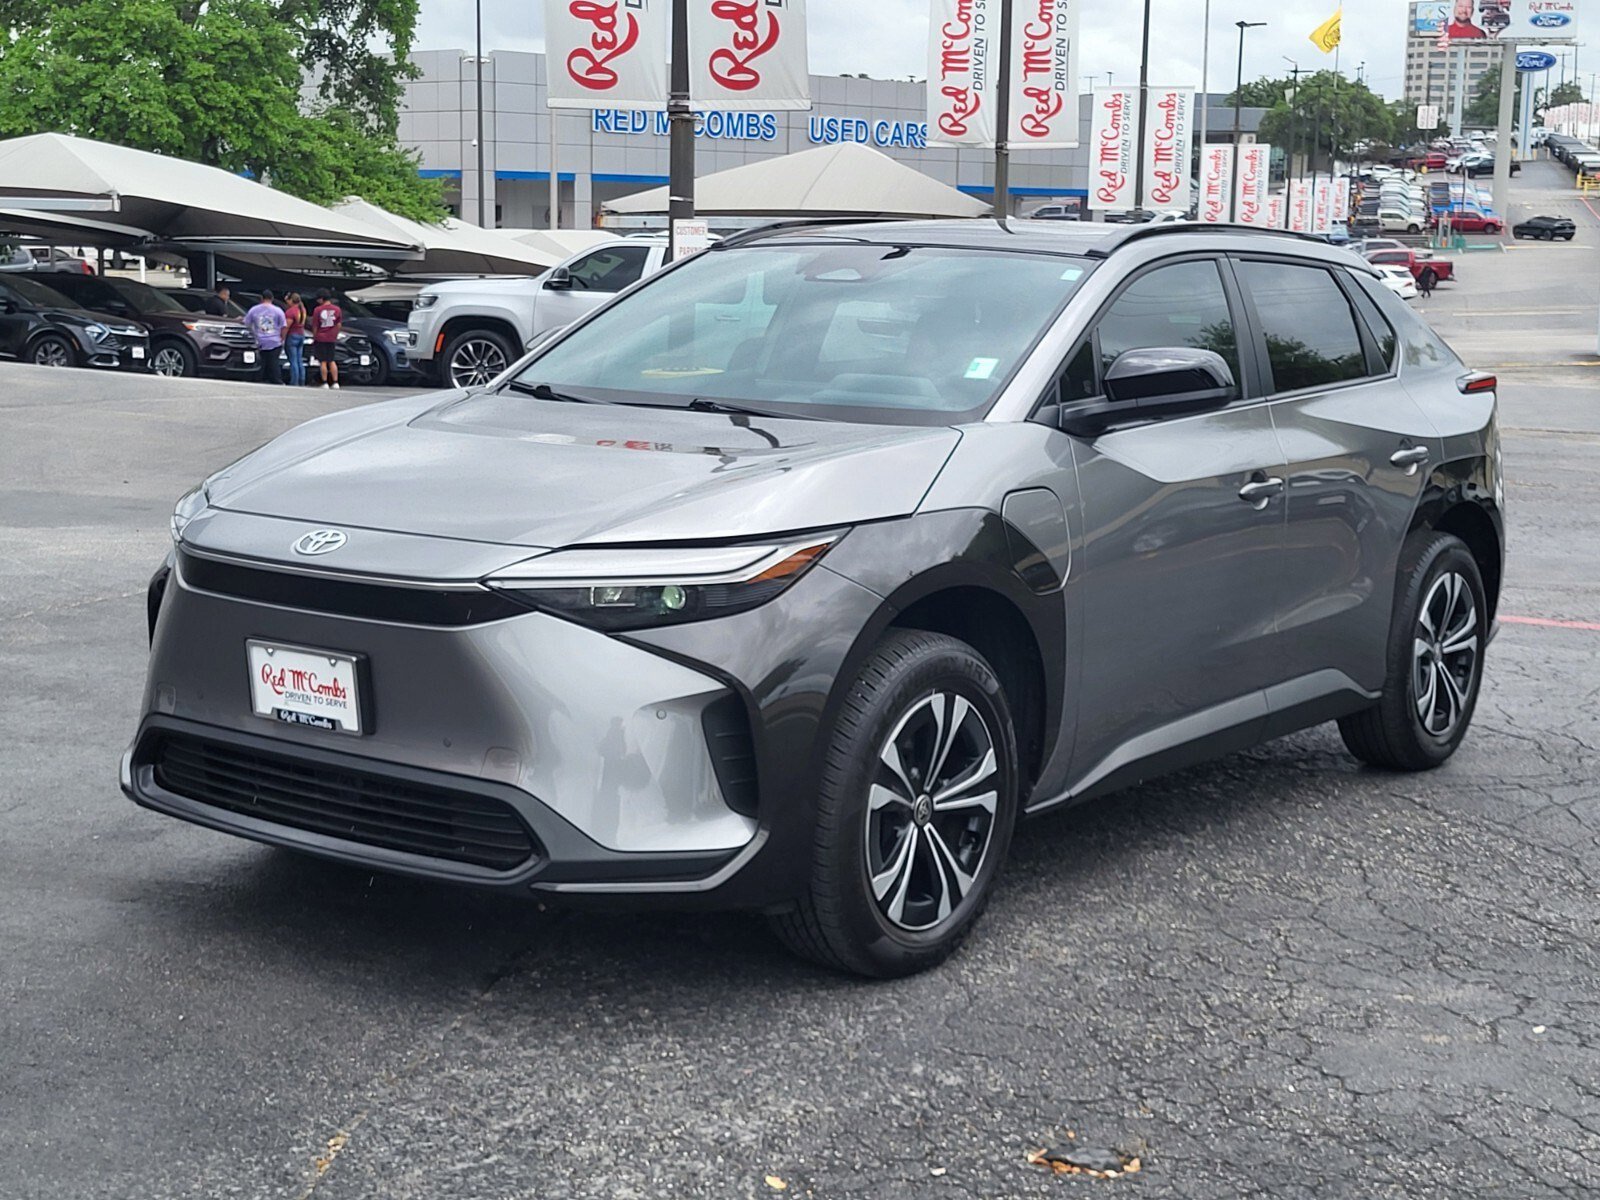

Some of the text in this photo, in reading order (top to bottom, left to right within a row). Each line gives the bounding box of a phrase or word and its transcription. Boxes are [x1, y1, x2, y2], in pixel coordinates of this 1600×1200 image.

[974, 13, 986, 33] TO
[1056, 13, 1067, 33] TO
[1536, 15, 1564, 26] Ford
[567, 0, 639, 90] Red
[709, 0, 780, 91] Red
[1516, 54, 1547, 68] Ford
[938, 0, 981, 137] Red McCom
[973, 38, 985, 91] DRIVEN
[1020, 0, 1063, 138] Red McCom
[1055, 38, 1067, 92] DRIVEN
[593, 109, 777, 141] RED MCOMBS
[809, 116, 869, 143] USED
[1122, 123, 1130, 136] TO
[1174, 93, 1186, 174] DRIVEN TO SERVE
[1097, 93, 1125, 202] Red McCombs
[1120, 139, 1129, 174] DRIVEN
[1151, 93, 1180, 203] Red McCombs
[1204, 200, 1223, 222] Red
[1240, 201, 1260, 222] Red
[261, 663, 347, 699] Red McCombs
[284, 690, 348, 710] DRIVEN TO SERVE
